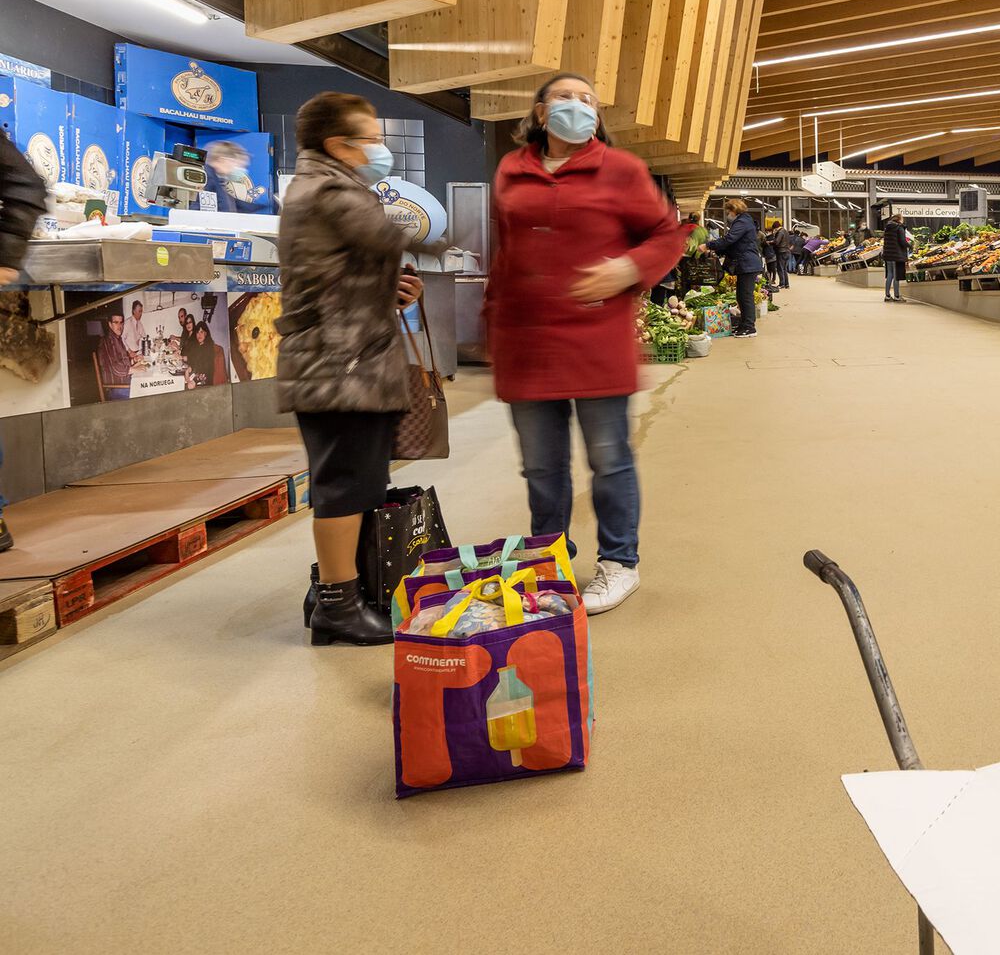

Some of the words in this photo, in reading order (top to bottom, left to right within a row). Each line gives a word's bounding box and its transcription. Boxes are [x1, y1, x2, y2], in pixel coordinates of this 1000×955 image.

[159, 107, 199, 120] BACALHAU
[199, 114, 234, 125] SUPERIOR
[896, 207, 923, 216] Tribunal
[925, 207, 934, 216] da
[237, 273, 275, 285] SABOR
[149, 379, 175, 387] NORUEGA
[406, 654, 466, 666] CONTINENTE
